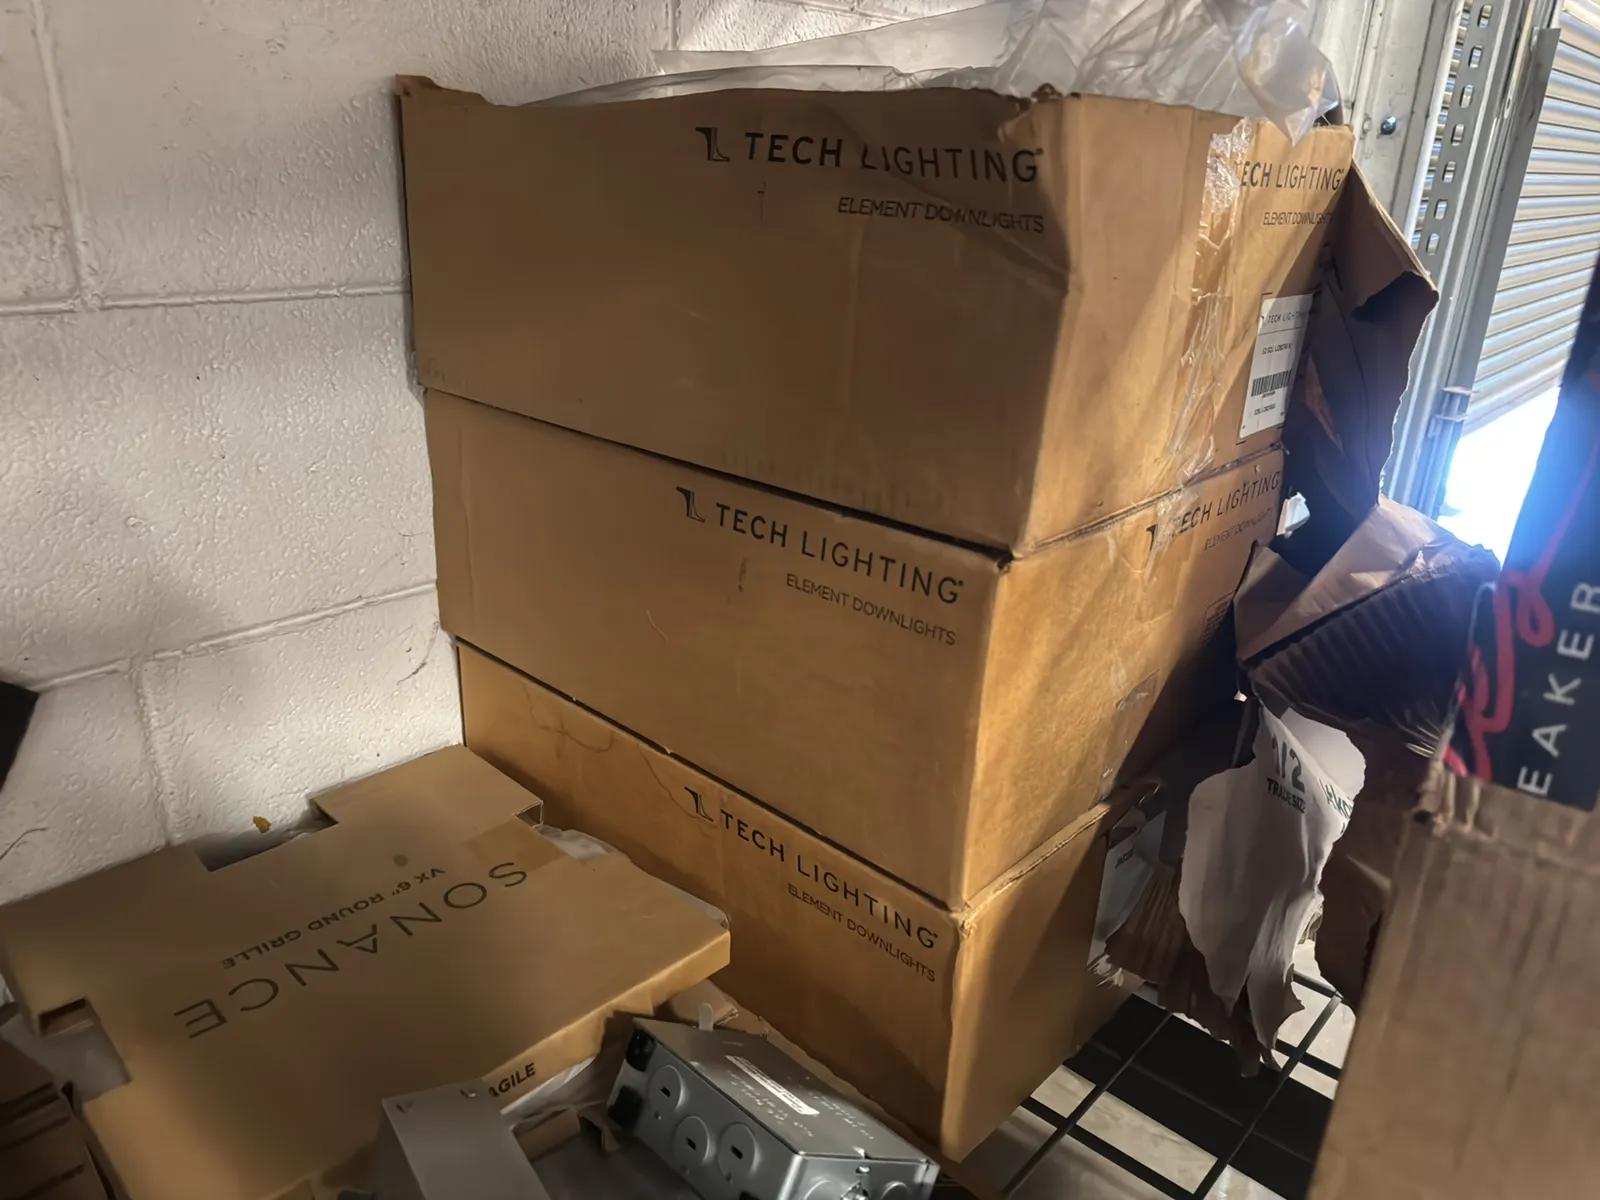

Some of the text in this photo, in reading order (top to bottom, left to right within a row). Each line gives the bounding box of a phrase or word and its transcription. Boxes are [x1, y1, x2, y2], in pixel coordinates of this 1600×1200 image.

[744, 132, 1039, 183] TECH LIGHTING
[1275, 163, 1344, 191] LIGHTING
[837, 197, 1045, 234] ELEMENT DOWNLIGHTS
[1216, 470, 1281, 517] LIGHTING
[715, 502, 960, 604] TECH LIGHTING
[786, 573, 956, 646] ELEMENT DOWNLIGHTS
[413, 867, 446, 884] VX
[720, 808, 936, 949] TECH LIGHTING
[307, 892, 386, 932] ROUND
[788, 883, 936, 983] ELEMENT DOWNLIGHTS
[173, 861, 528, 1040] SONANCE
[220, 929, 302, 971] GRILLE
